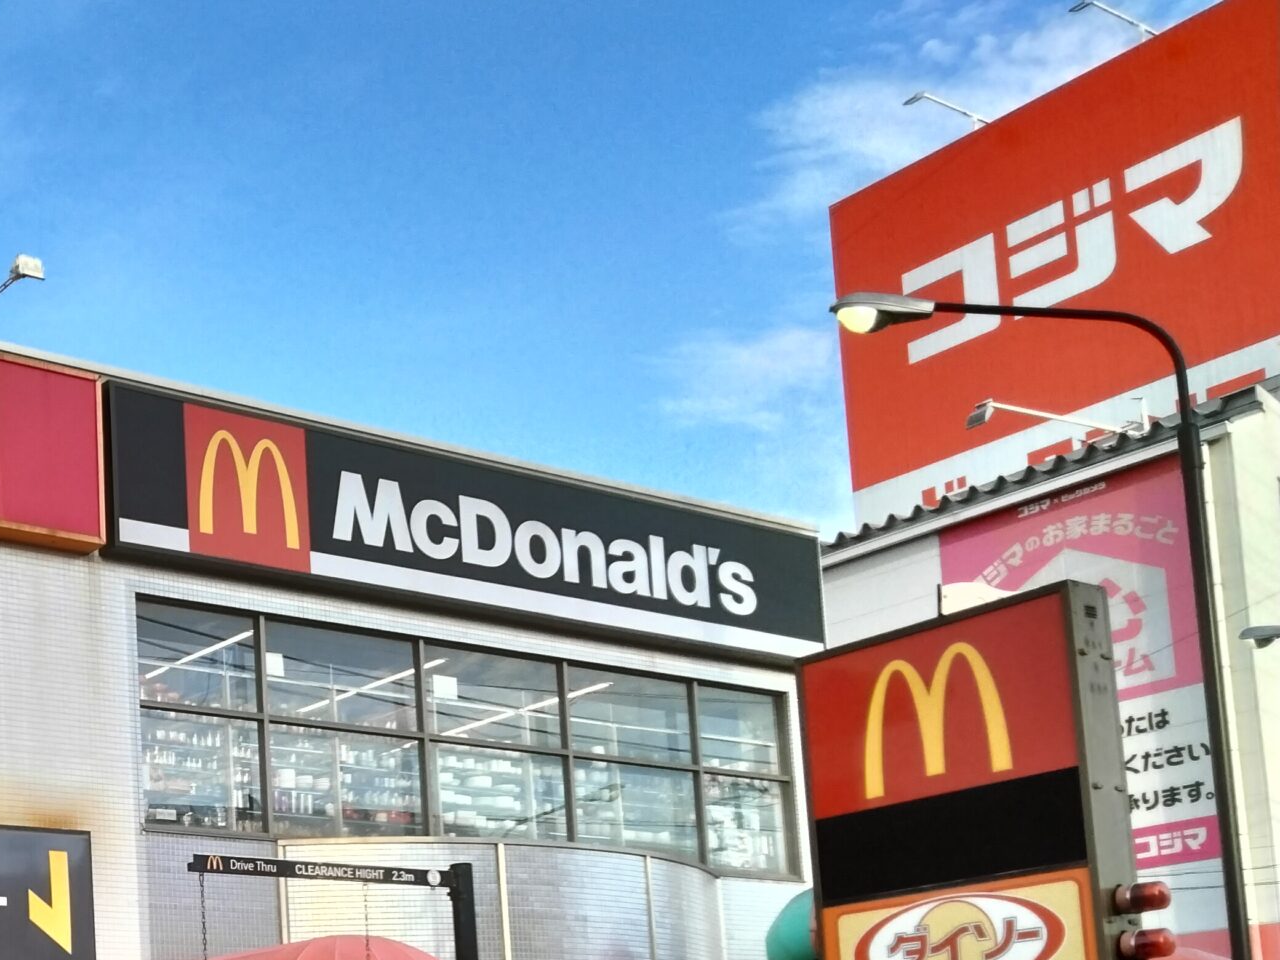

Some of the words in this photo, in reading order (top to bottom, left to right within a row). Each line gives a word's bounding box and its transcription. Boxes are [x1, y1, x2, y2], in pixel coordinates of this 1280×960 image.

[901, 116, 1242, 364] コジマ
[332, 470, 757, 617] McDonald's
[1120, 708, 1170, 738] たは
[1125, 742, 1211, 775] ください
[1135, 826, 1208, 859] コジマ
[230, 859, 254, 871] Drive
[256, 861, 277, 873] Thru
[295, 864, 354, 878] CLEARANCE
[355, 868, 385, 880] HIGHT
[392, 870, 415, 882] 2.3m
